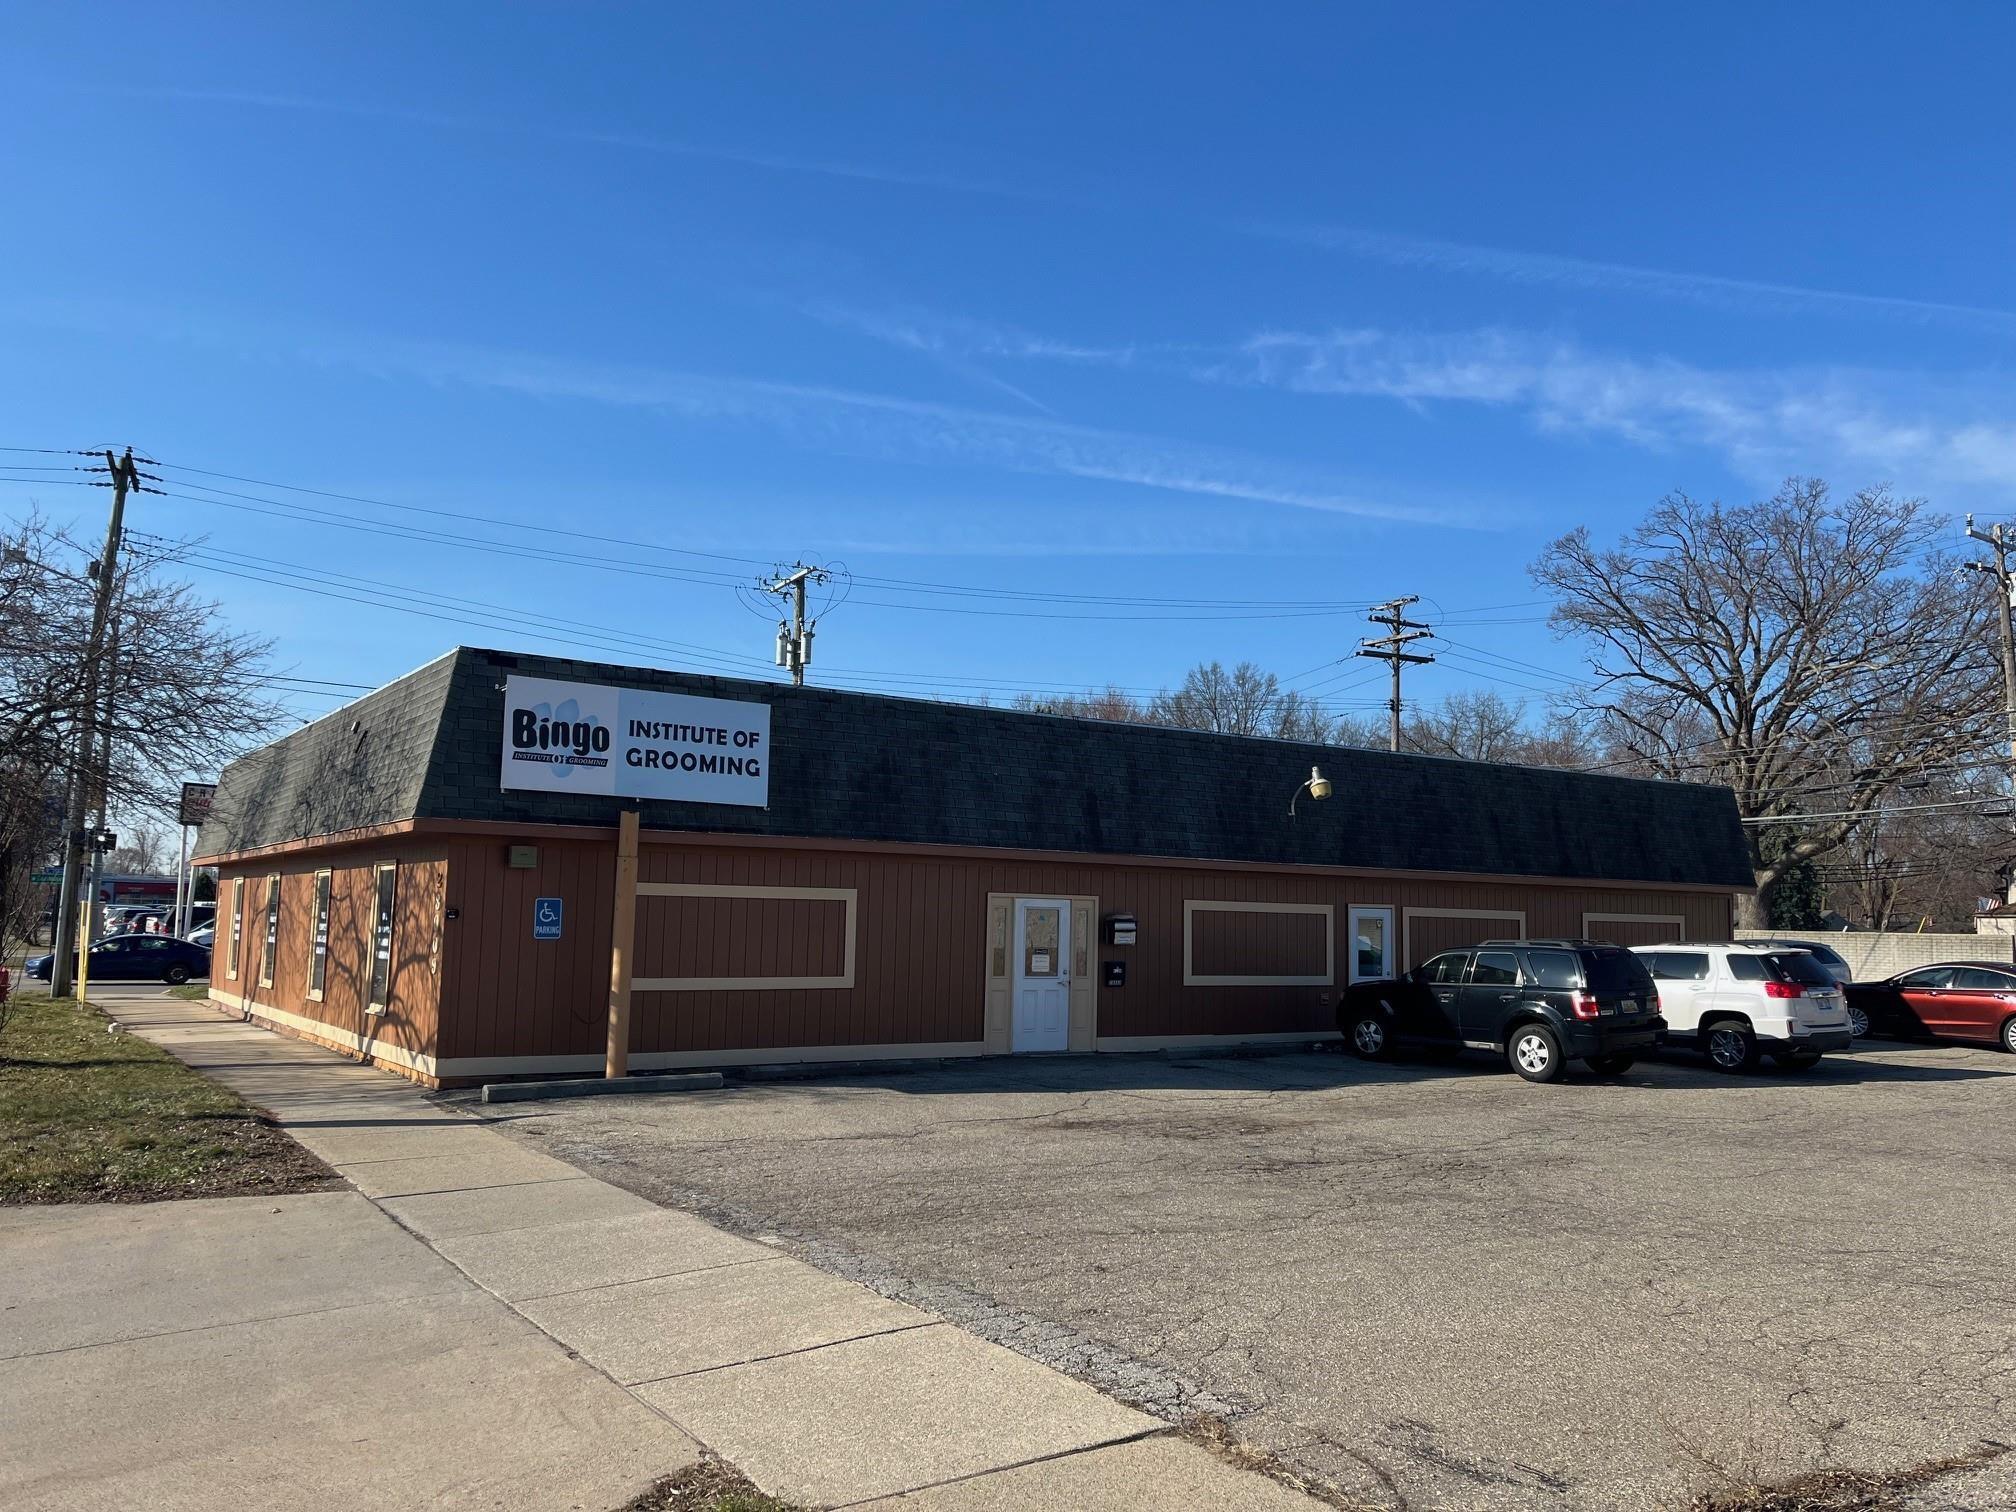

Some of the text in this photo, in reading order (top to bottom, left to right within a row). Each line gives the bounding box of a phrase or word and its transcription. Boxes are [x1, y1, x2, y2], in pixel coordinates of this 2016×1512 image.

[512, 708, 610, 756] Bingo
[628, 719, 760, 749] INSTITUTE OF
[513, 753, 551, 761] INSTITUTE
[569, 757, 607, 766] GROOMING
[625, 747, 761, 777] GROOMING
[535, 925, 560, 935] PARKING
